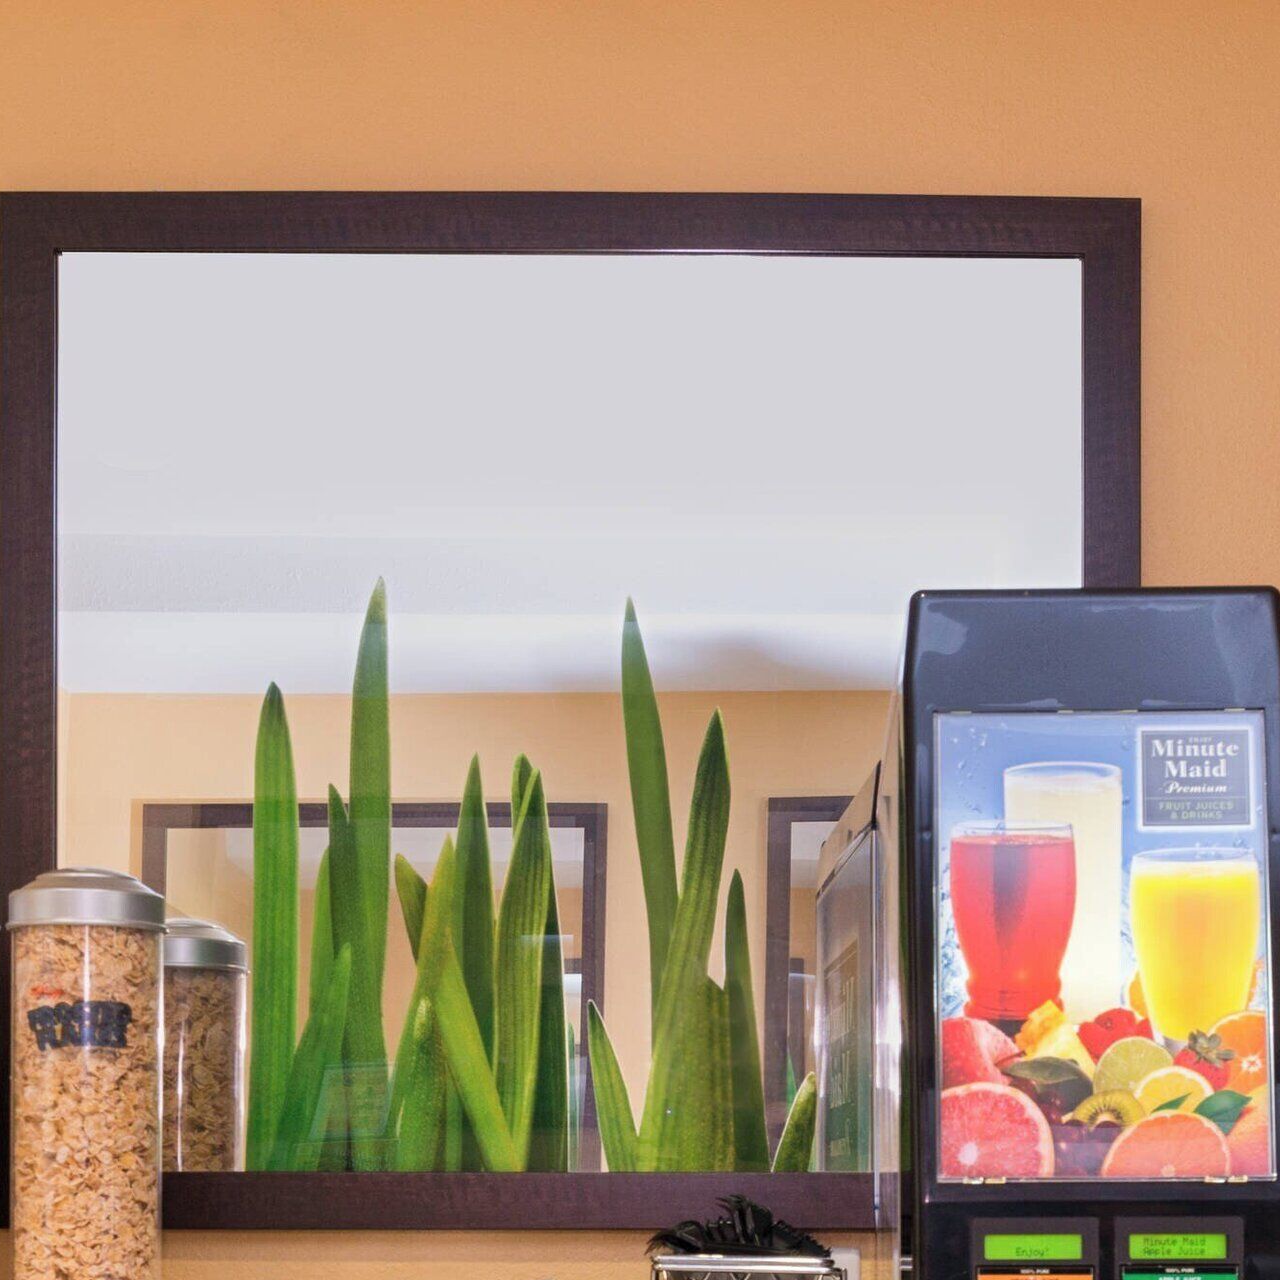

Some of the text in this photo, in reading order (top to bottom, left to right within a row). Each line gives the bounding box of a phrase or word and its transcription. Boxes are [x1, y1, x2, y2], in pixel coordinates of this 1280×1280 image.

[1152, 740, 1239, 757] Minute
[1165, 759, 1227, 778] Maid
[1165, 781, 1227, 794] Premium
[1159, 801, 1234, 810] FRUIT JUICES
[1182, 811, 1223, 819] DRINKS
[1143, 1237, 1206, 1246] Minute Maid
